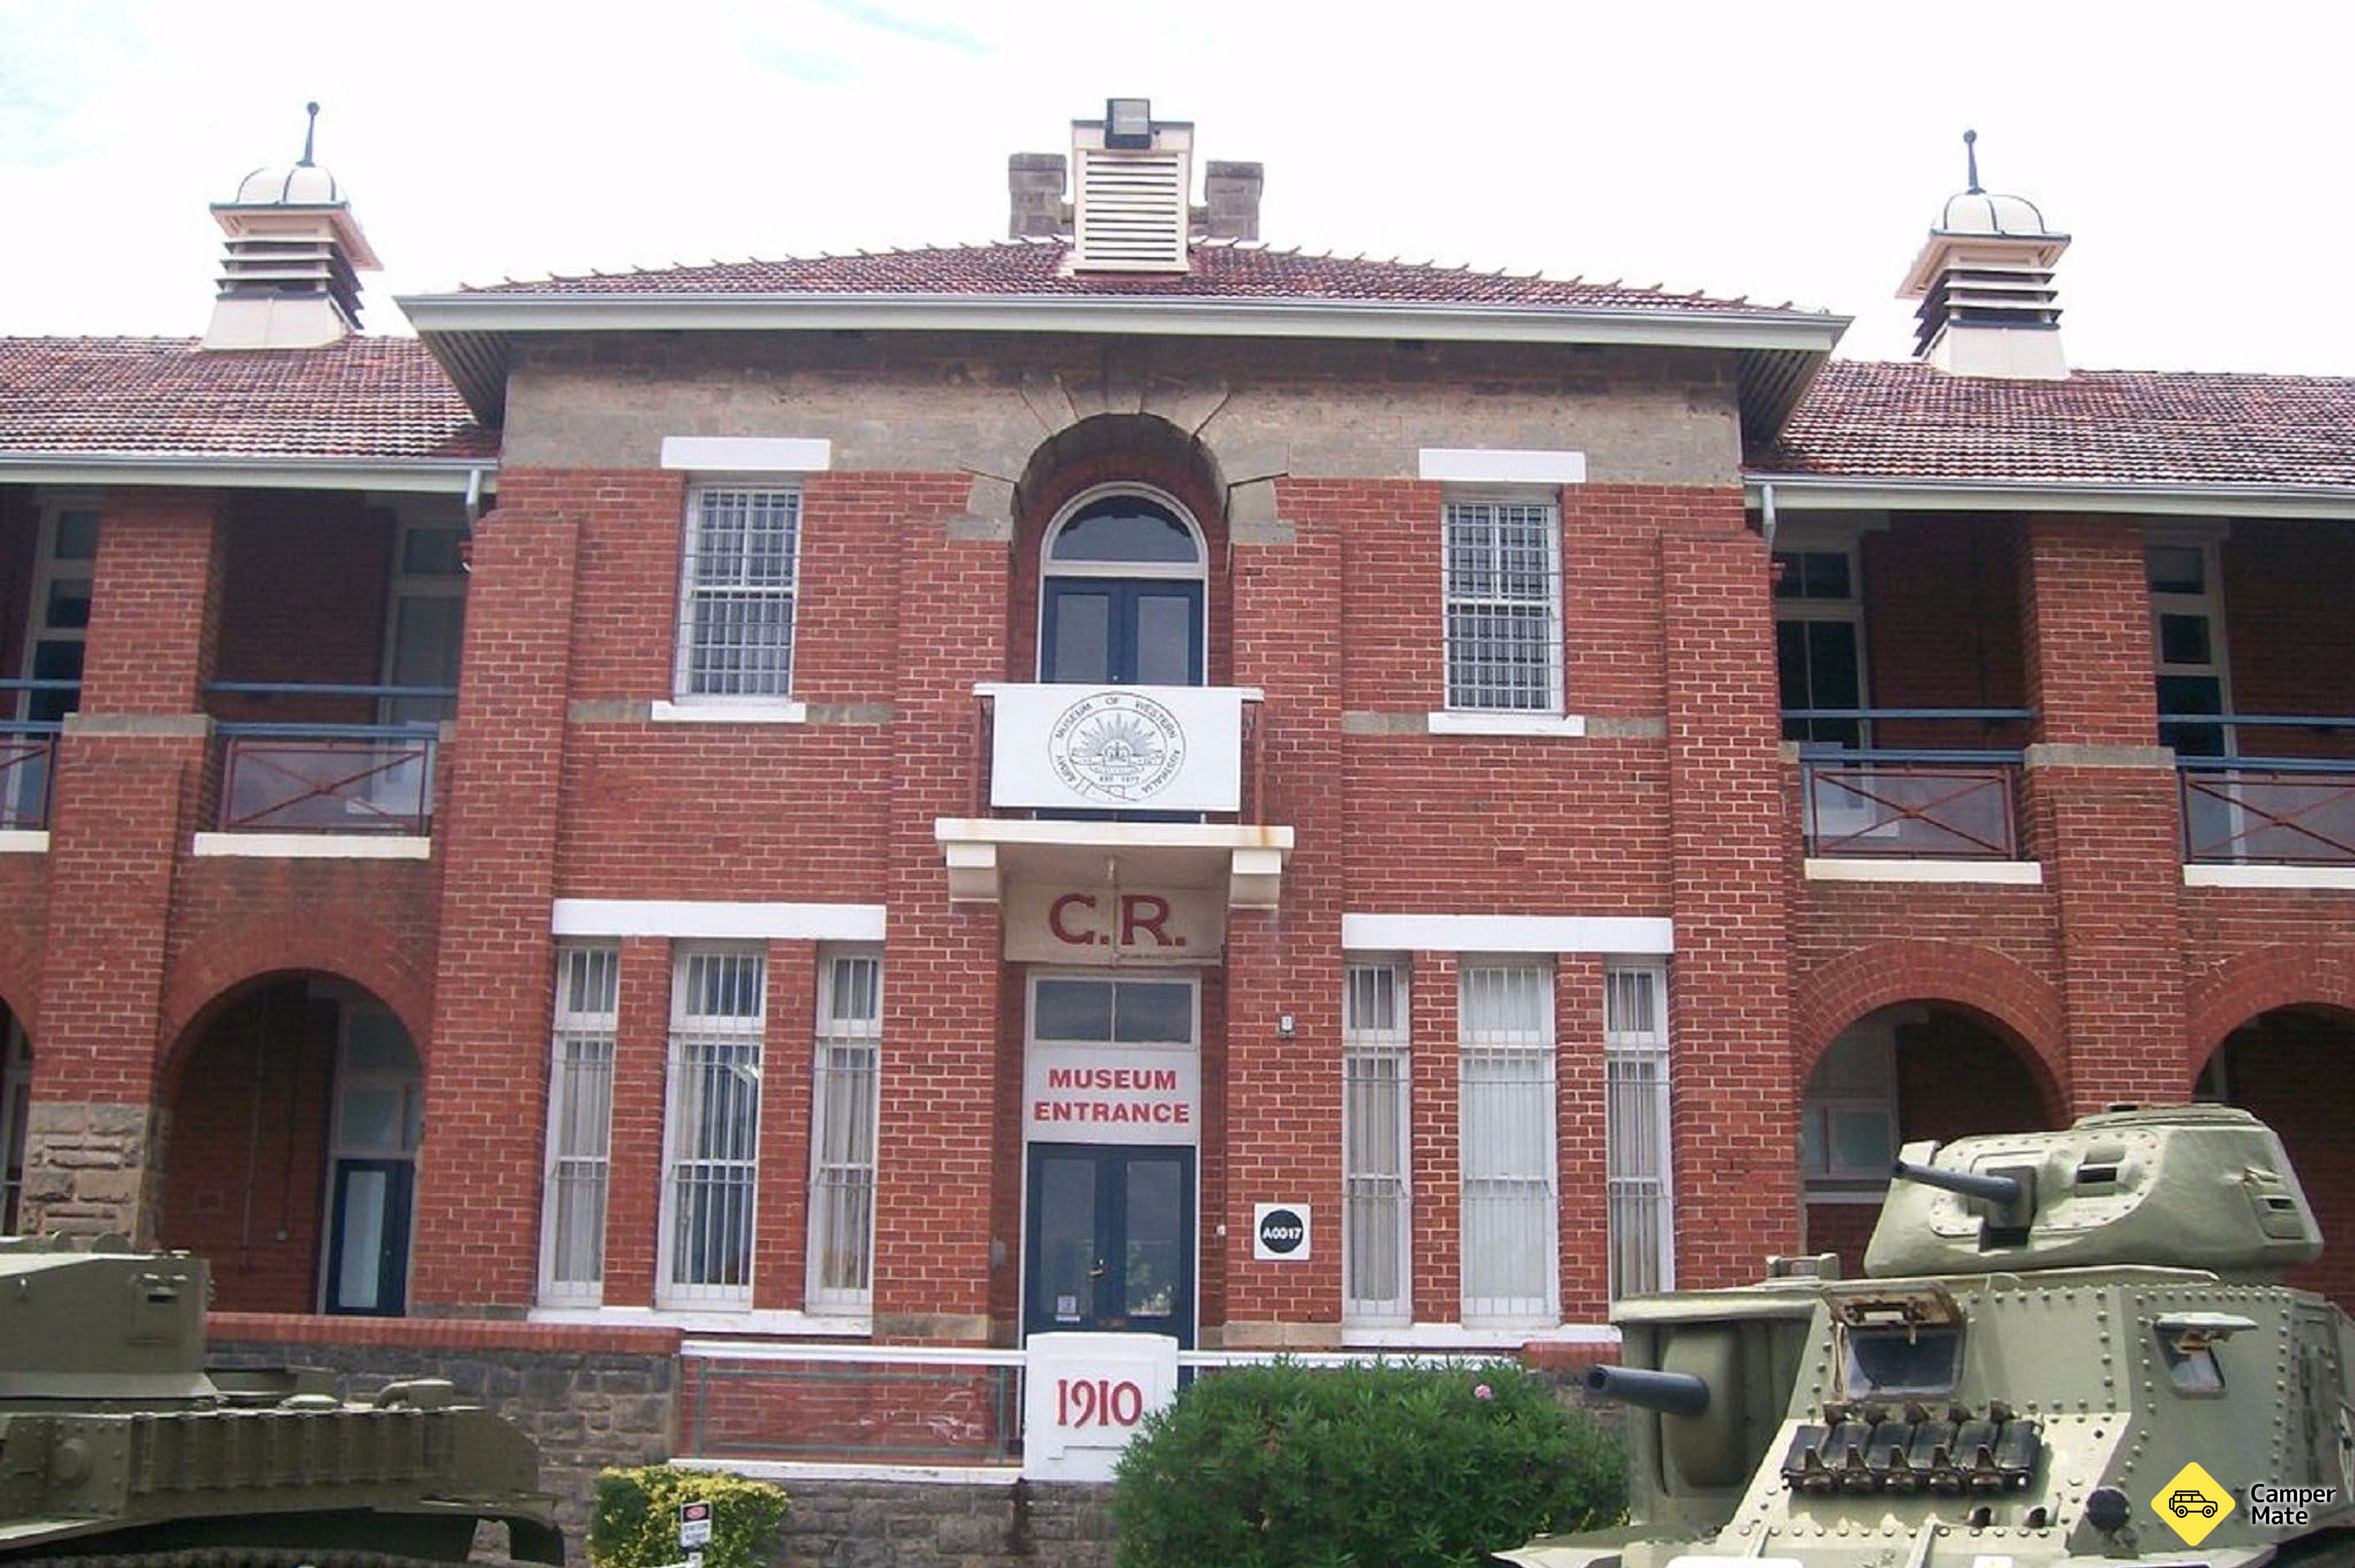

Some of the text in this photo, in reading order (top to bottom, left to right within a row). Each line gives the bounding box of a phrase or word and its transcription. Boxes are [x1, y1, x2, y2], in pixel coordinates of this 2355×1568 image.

[1104, 697, 1119, 706] OF
[1135, 700, 1178, 739] WESTERN
[1055, 702, 1094, 738] MUSEUM
[1141, 750, 1180, 793] AUSTRALIA
[1049, 1069, 1176, 1089] MUSEUM
[1034, 1101, 1189, 1123] ENTRANCE
[1057, 1378, 1142, 1429] 1910
